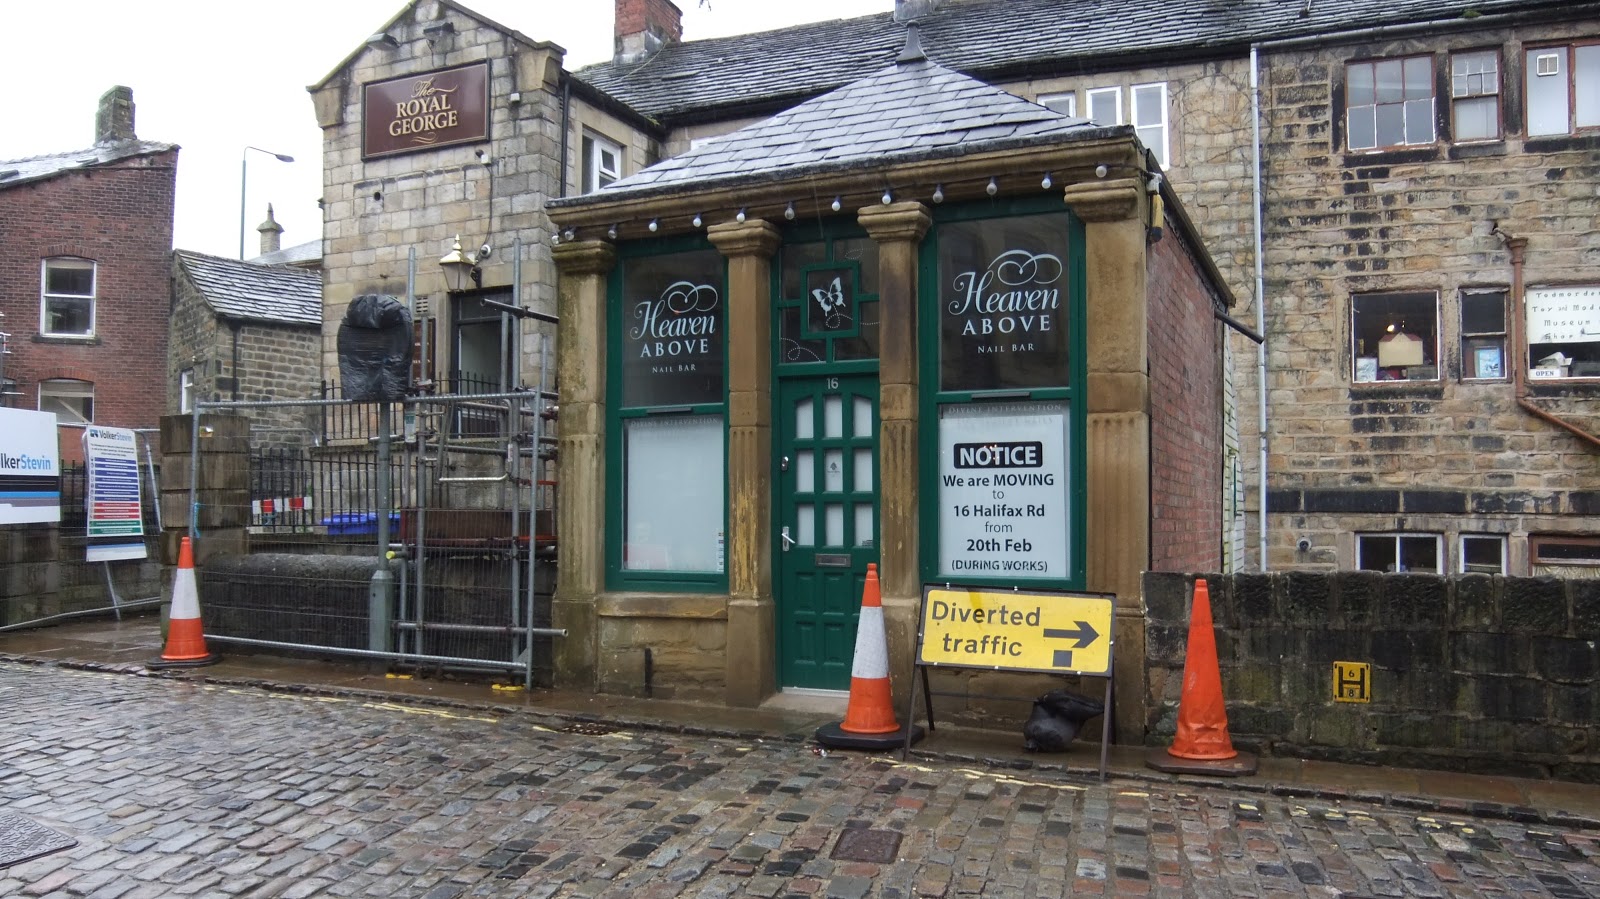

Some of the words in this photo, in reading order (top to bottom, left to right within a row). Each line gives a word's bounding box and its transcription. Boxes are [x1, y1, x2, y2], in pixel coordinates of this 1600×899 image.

[411, 77, 457, 98] The
[396, 94, 451, 118] ROYAL
[389, 110, 458, 137] GEORGE
[948, 270, 1060, 316] Heaven
[629, 299, 716, 340] Heaven
[961, 314, 1051, 336] ABOVE
[640, 338, 709, 358] ABOVE
[977, 345, 1005, 354] NAIL
[1011, 343, 1035, 352] BAR
[652, 366, 674, 374] NAIL
[678, 363, 697, 372] BAR
[827, 377, 839, 390] 16
[959, 446, 1037, 466] NOTICE
[943, 475, 964, 487] We
[967, 477, 990, 487] are
[993, 474, 1054, 486] MOVING
[992, 490, 1005, 499] to
[954, 505, 970, 517] 16
[973, 504, 1023, 517] Halifax
[1026, 504, 1045, 517] Rd
[985, 521, 1013, 533] from
[966, 539, 1000, 552] 20th
[1005, 539, 1032, 552] Feb
[951, 560, 1000, 571] (DURING
[1001, 561, 1048, 572] WORKS)
[931, 600, 1041, 627] Diverted
[942, 632, 1023, 657] traffic
[1338, 666, 1365, 699] H
